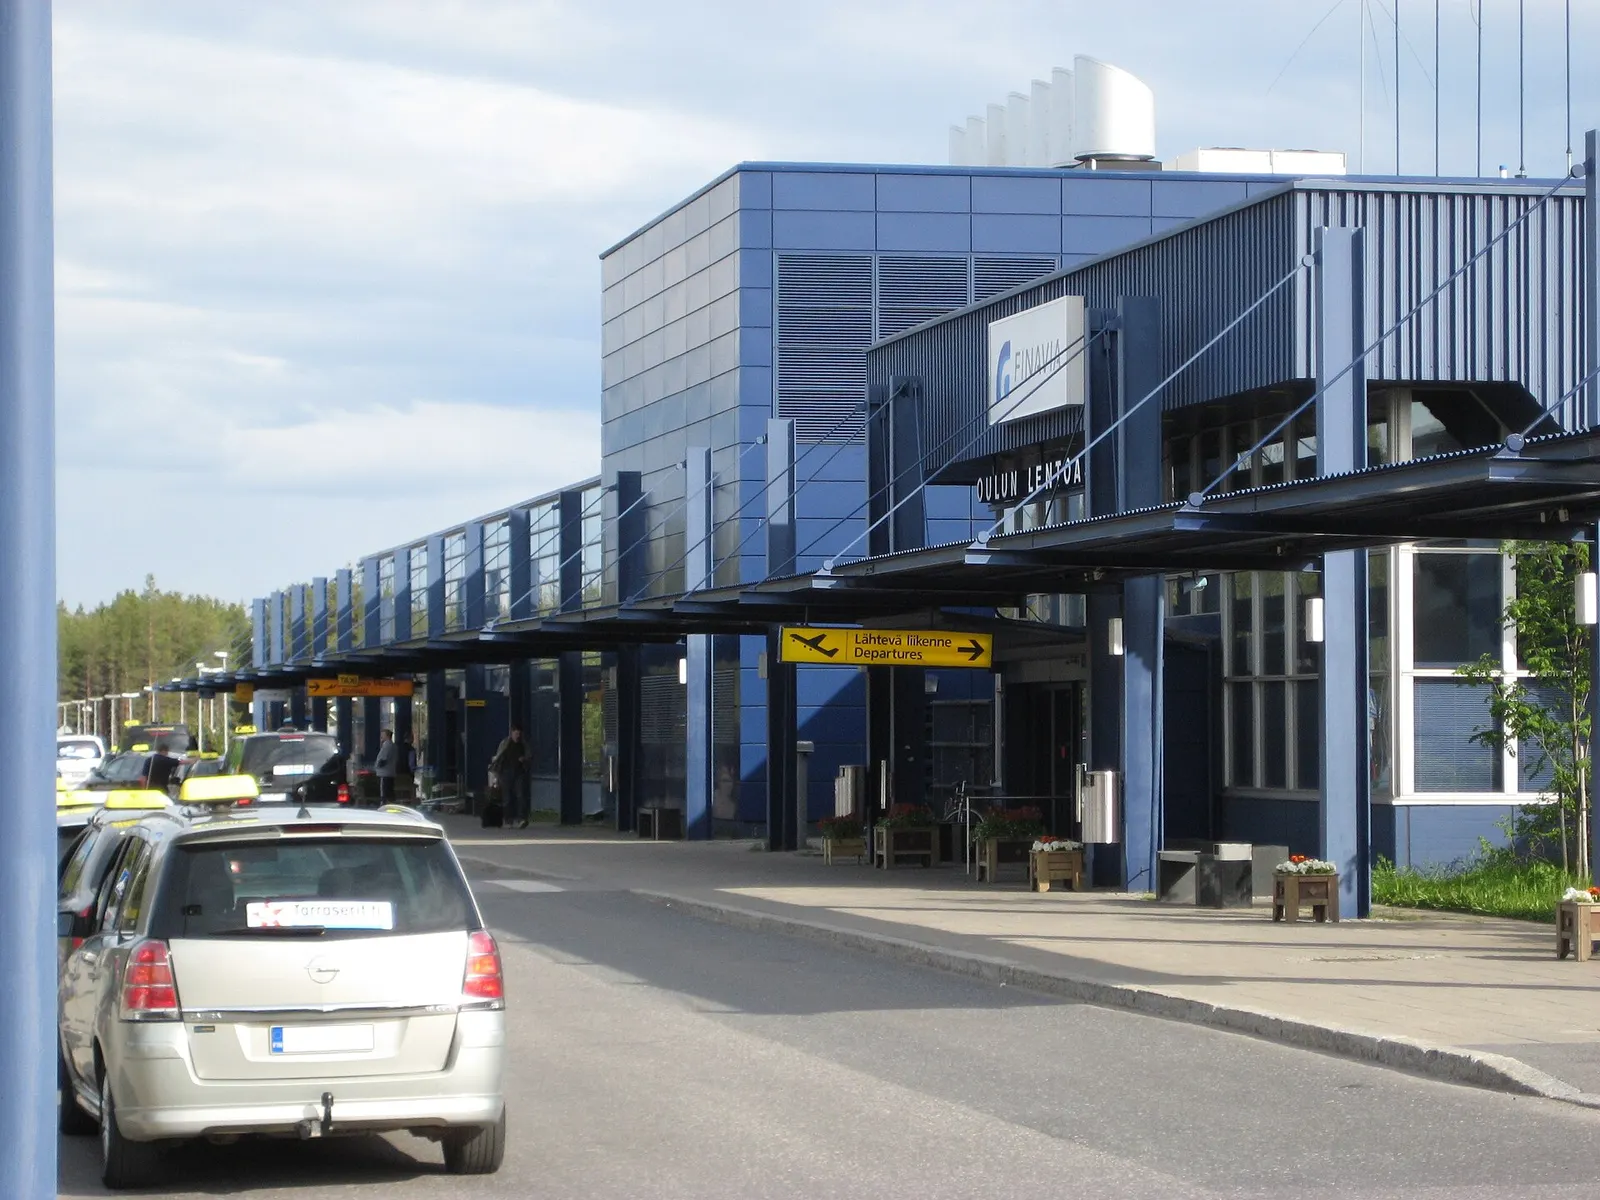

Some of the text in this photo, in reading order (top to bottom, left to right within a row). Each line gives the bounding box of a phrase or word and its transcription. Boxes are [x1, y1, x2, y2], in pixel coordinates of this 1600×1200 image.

[1014, 338, 1061, 382] FINAVIA
[976, 470, 1018, 503] OULUN
[855, 633, 952, 648] Lähtevä liikenne
[854, 647, 922, 661] Departures
